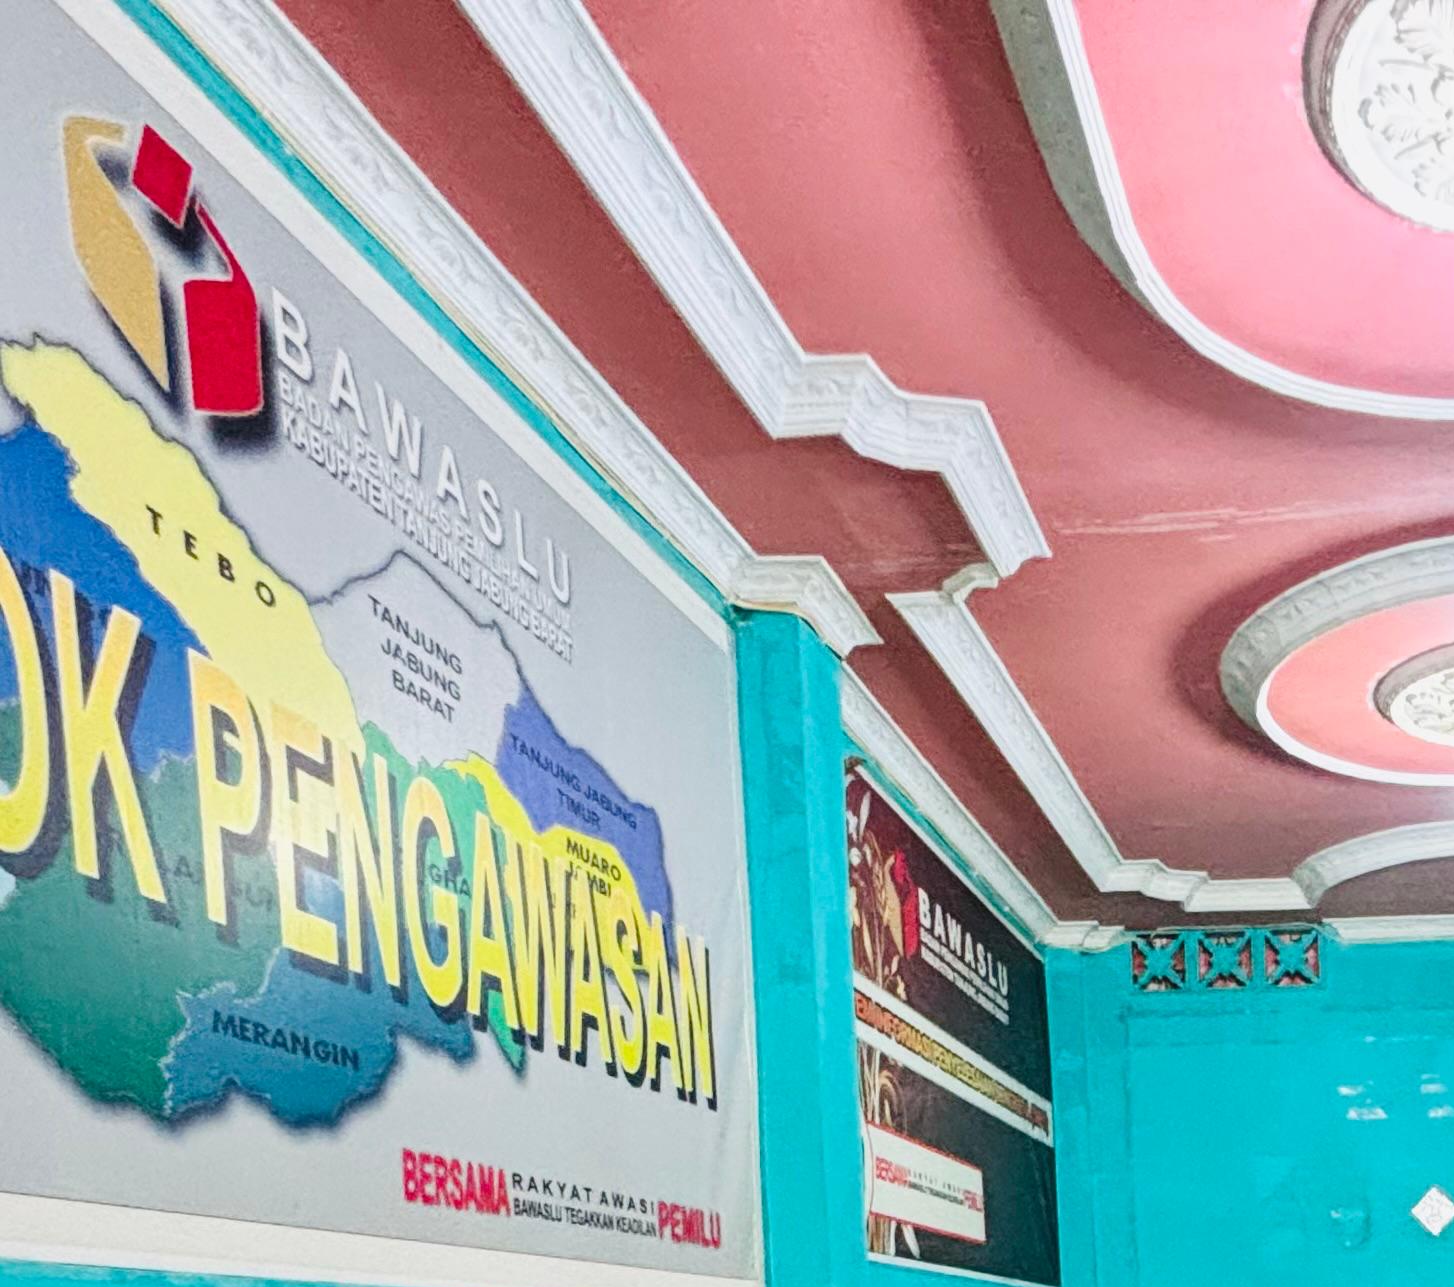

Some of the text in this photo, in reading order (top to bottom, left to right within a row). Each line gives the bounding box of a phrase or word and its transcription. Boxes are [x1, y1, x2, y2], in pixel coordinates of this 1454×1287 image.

[272, 286, 571, 607] BAWASLU
[145, 503, 277, 608] TEBO
[367, 593, 463, 676] TANJUNG
[380, 637, 462, 702] JABUNG
[391, 669, 456, 724] BARAT
[509, 731, 582, 792] TANJUNG
[187, 646, 716, 1110] PENGAWASAN
[566, 836, 622, 882] MUARO
[568, 861, 612, 897] JMBI
[917, 887, 1009, 997] BAWASLU
[211, 1009, 360, 1072] MERANGIN
[402, 1147, 722, 1250] BERSAMA RAKYAT AWASI PEMILU
[513, 1197, 564, 1225] BAWASLU
